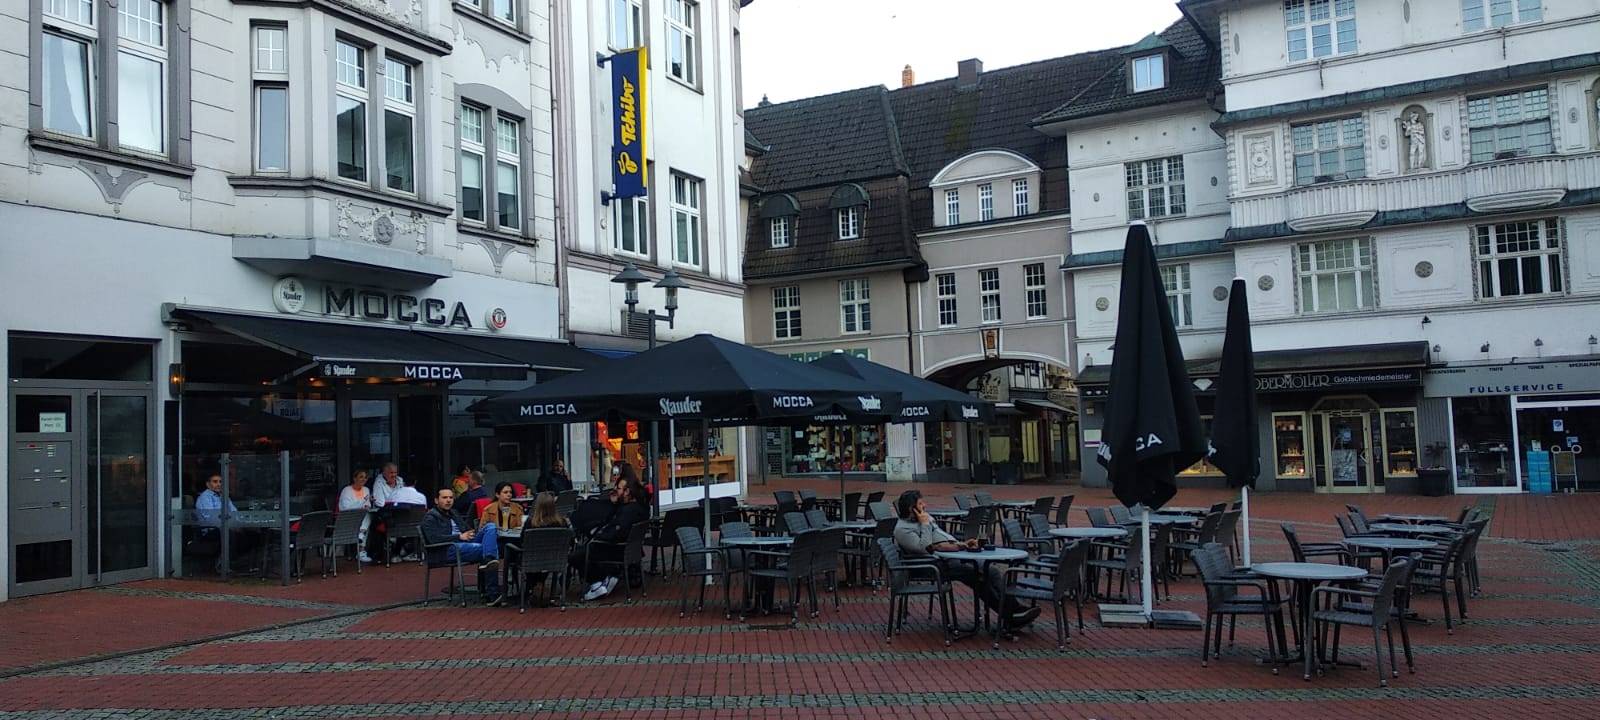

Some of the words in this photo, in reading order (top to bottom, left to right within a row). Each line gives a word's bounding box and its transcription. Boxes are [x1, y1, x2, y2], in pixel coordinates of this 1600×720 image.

[620, 75, 637, 146] Tchibo
[324, 285, 473, 328] MOCCA
[404, 366, 463, 379] MOCCA
[1469, 383, 1564, 393] FÜLLSERVICE
[659, 396, 702, 417] Stauder
[773, 396, 815, 408] MOCCA
[520, 403, 578, 416] MOCCA
